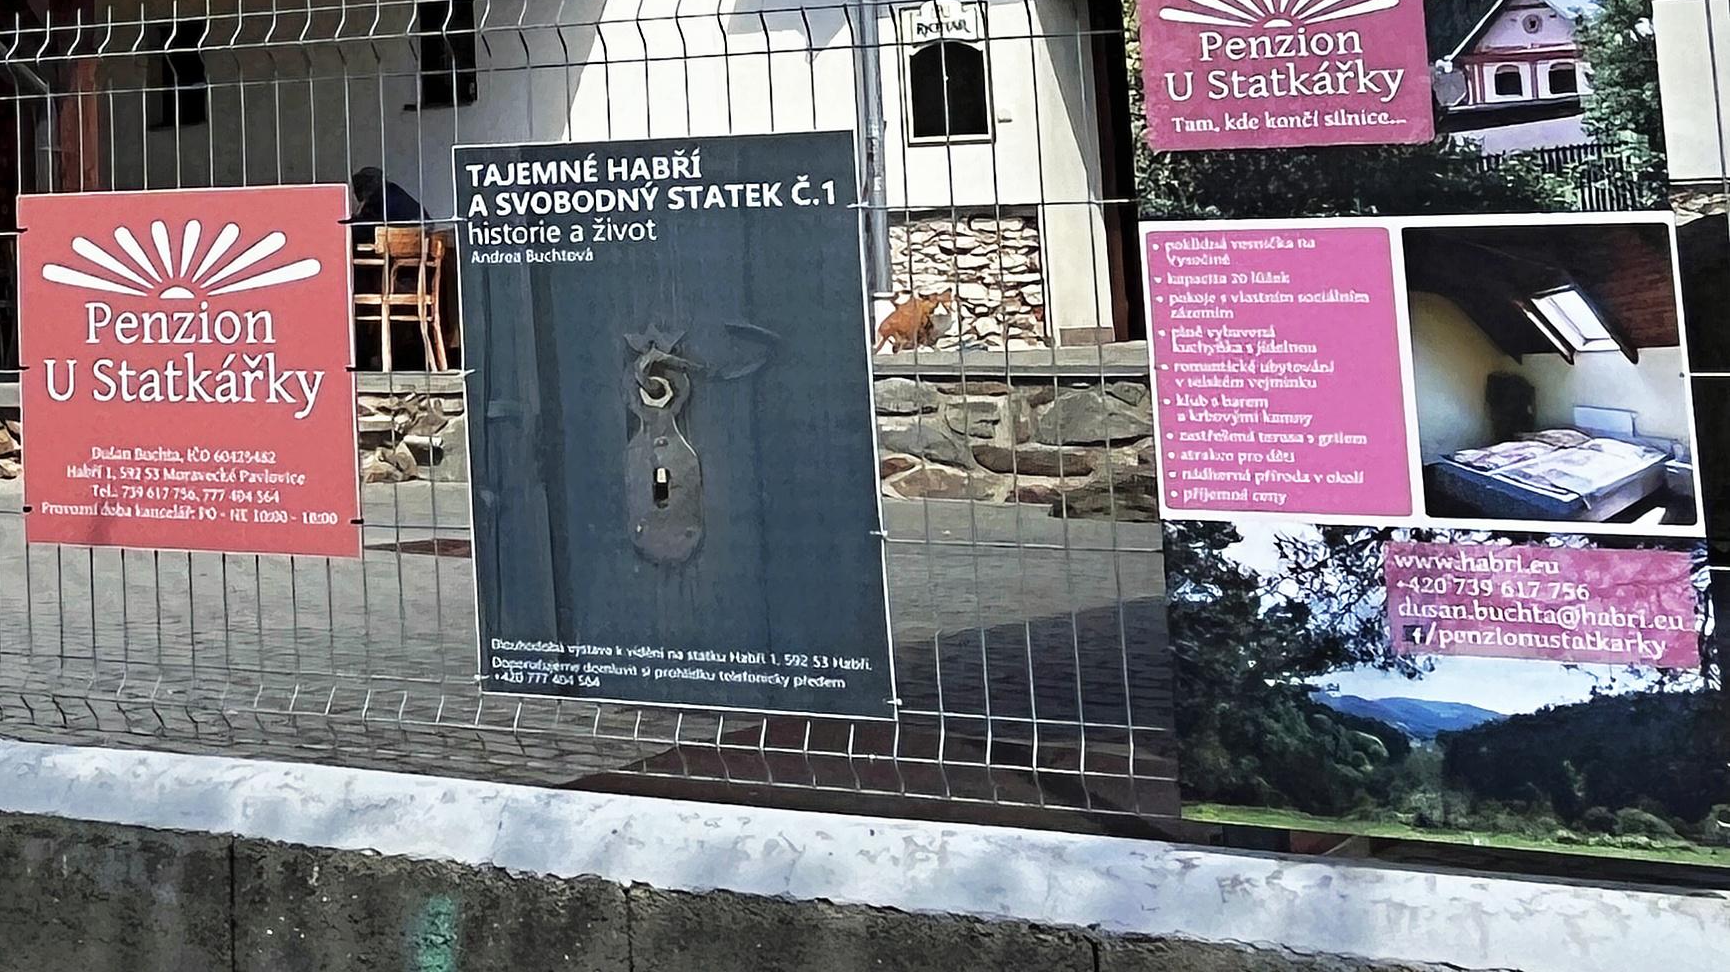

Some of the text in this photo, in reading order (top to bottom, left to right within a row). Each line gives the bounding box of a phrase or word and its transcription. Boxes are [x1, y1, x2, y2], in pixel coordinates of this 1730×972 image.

[1199, 27, 1363, 62] Penzion
[1165, 59, 1405, 103] U Statkářky
[1171, 110, 1407, 133] Tam, kde končí silnice...
[465, 146, 703, 187] TAJEMNÉ HABŘÍ
[468, 174, 836, 218] A SVOBODNÝ STATEK Č.1
[468, 217, 657, 246] historie a život
[471, 246, 594, 264] Andrea Buchtová
[1231, 273, 1248, 284] 20
[1231, 290, 1294, 303] vlastním
[84, 301, 276, 344] Penzion
[44, 352, 325, 419] U Statkářky
[1175, 378, 1184, 389] v
[1176, 393, 1208, 407] klub
[92, 446, 131, 460] Dušan
[1238, 452, 1263, 465] pro
[120, 467, 141, 480] 592
[144, 467, 160, 480] 53
[122, 485, 144, 499] 739
[146, 487, 169, 500] 617
[203, 488, 225, 502] 777
[1394, 551, 1560, 575] www.habri.eu
[1454, 578, 1493, 597] 739
[1501, 581, 1539, 599] 617
[1547, 583, 1590, 601] 756
[668, 650, 684, 660] na
[784, 654, 808, 667] 592
[813, 655, 829, 668] 53
[527, 672, 548, 684] 777
